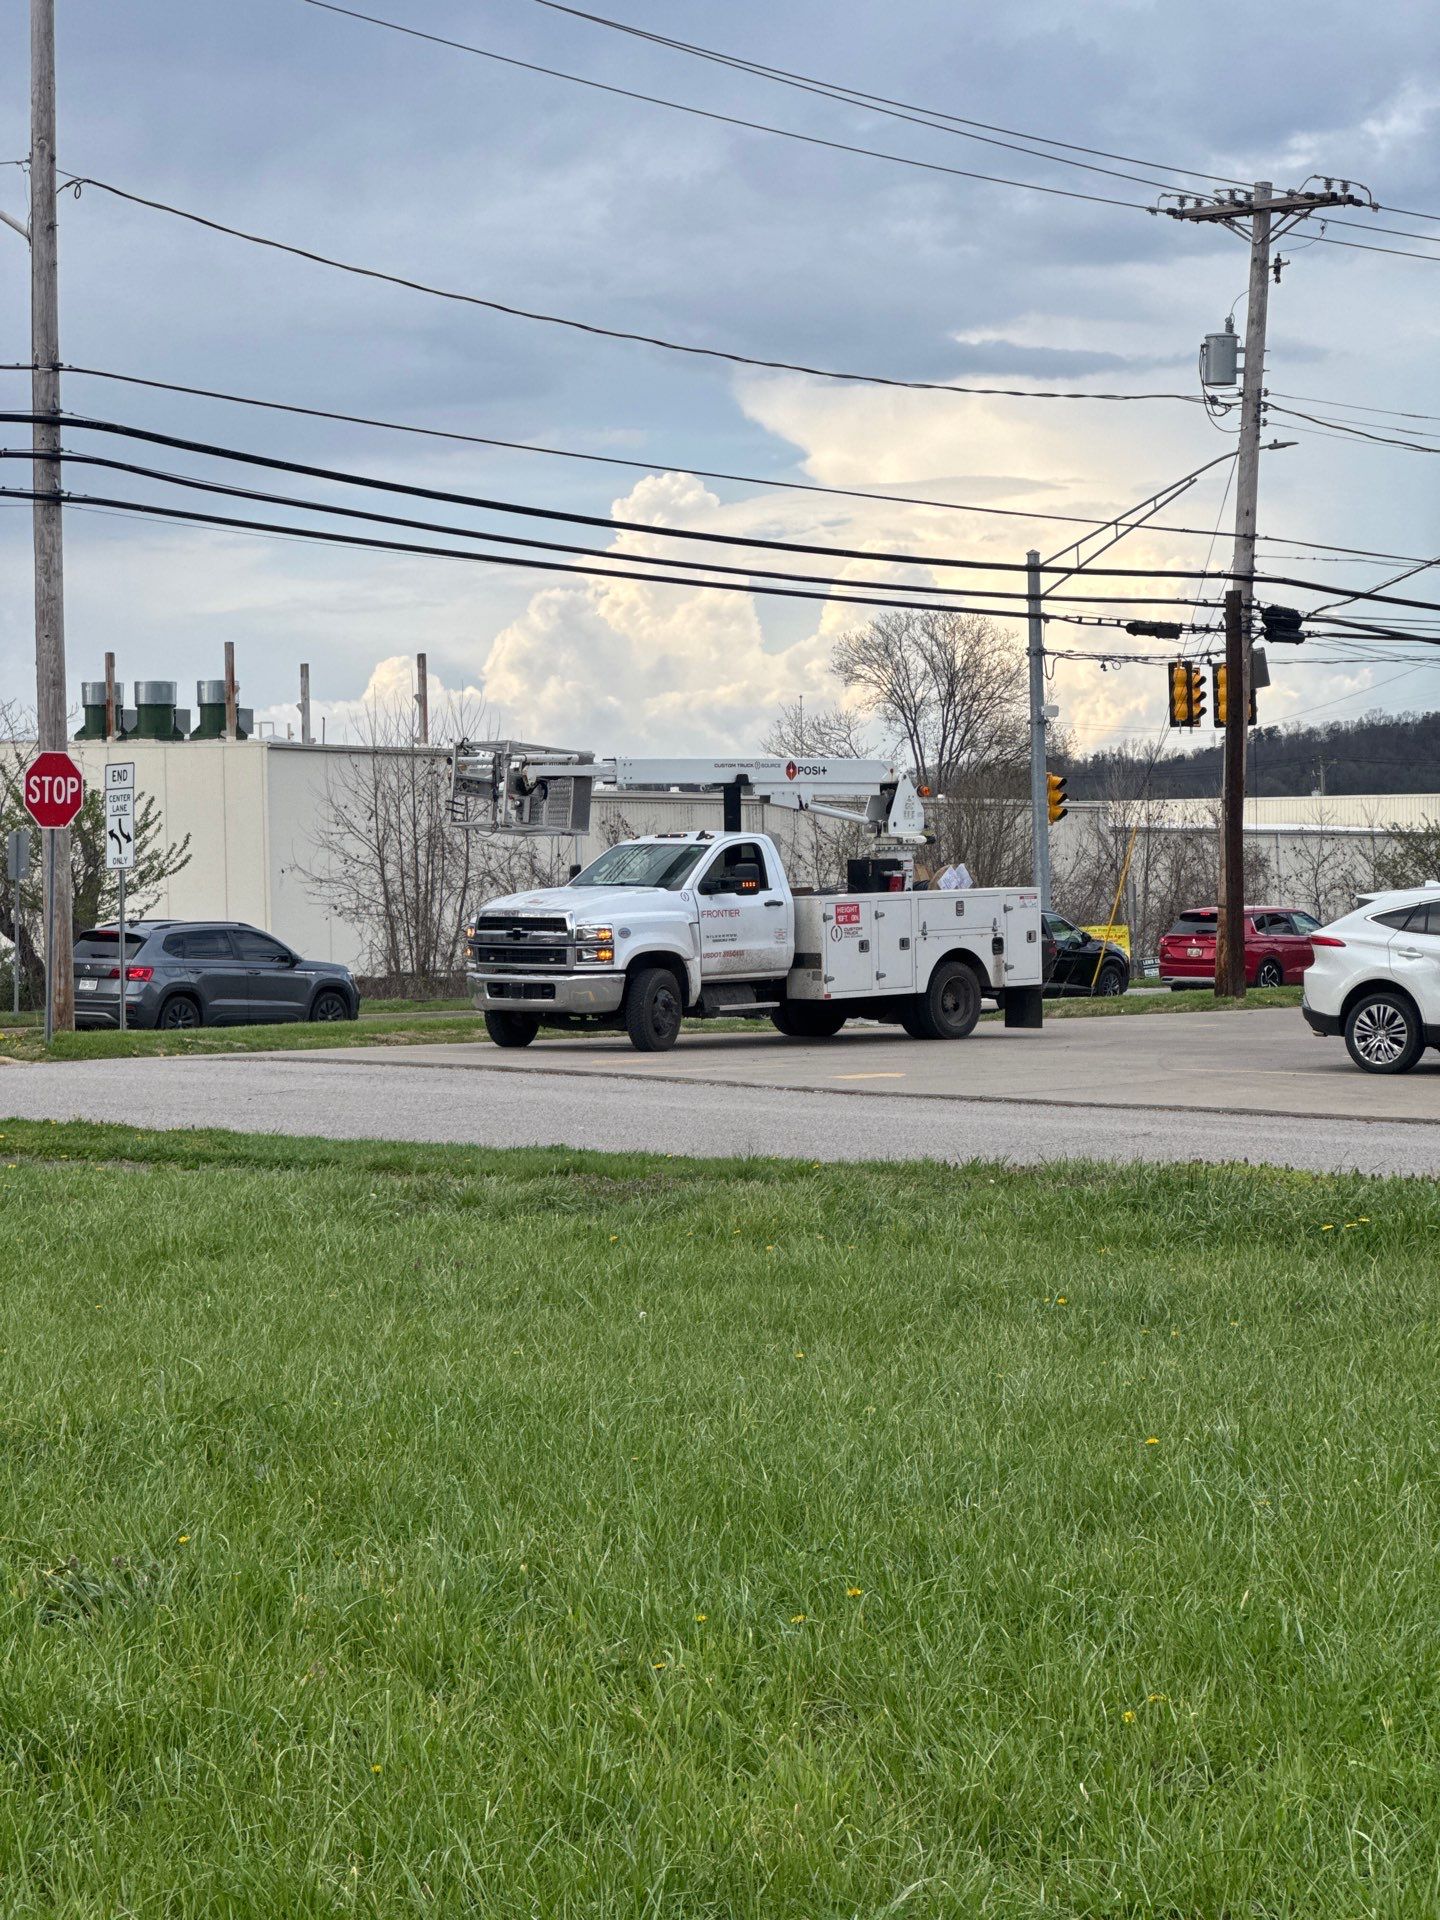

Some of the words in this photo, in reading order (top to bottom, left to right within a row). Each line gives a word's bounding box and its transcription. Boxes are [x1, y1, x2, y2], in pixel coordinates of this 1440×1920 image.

[112, 769, 128, 782] END
[28, 775, 79, 804] STOP
[109, 793, 131, 803] CENTER
[112, 804, 128, 812] LANE
[112, 856, 129, 865] ONLY
[701, 909, 741, 918] FRONTIER
[836, 905, 858, 914] HEIGHT
[702, 951, 721, 959] USDOT
